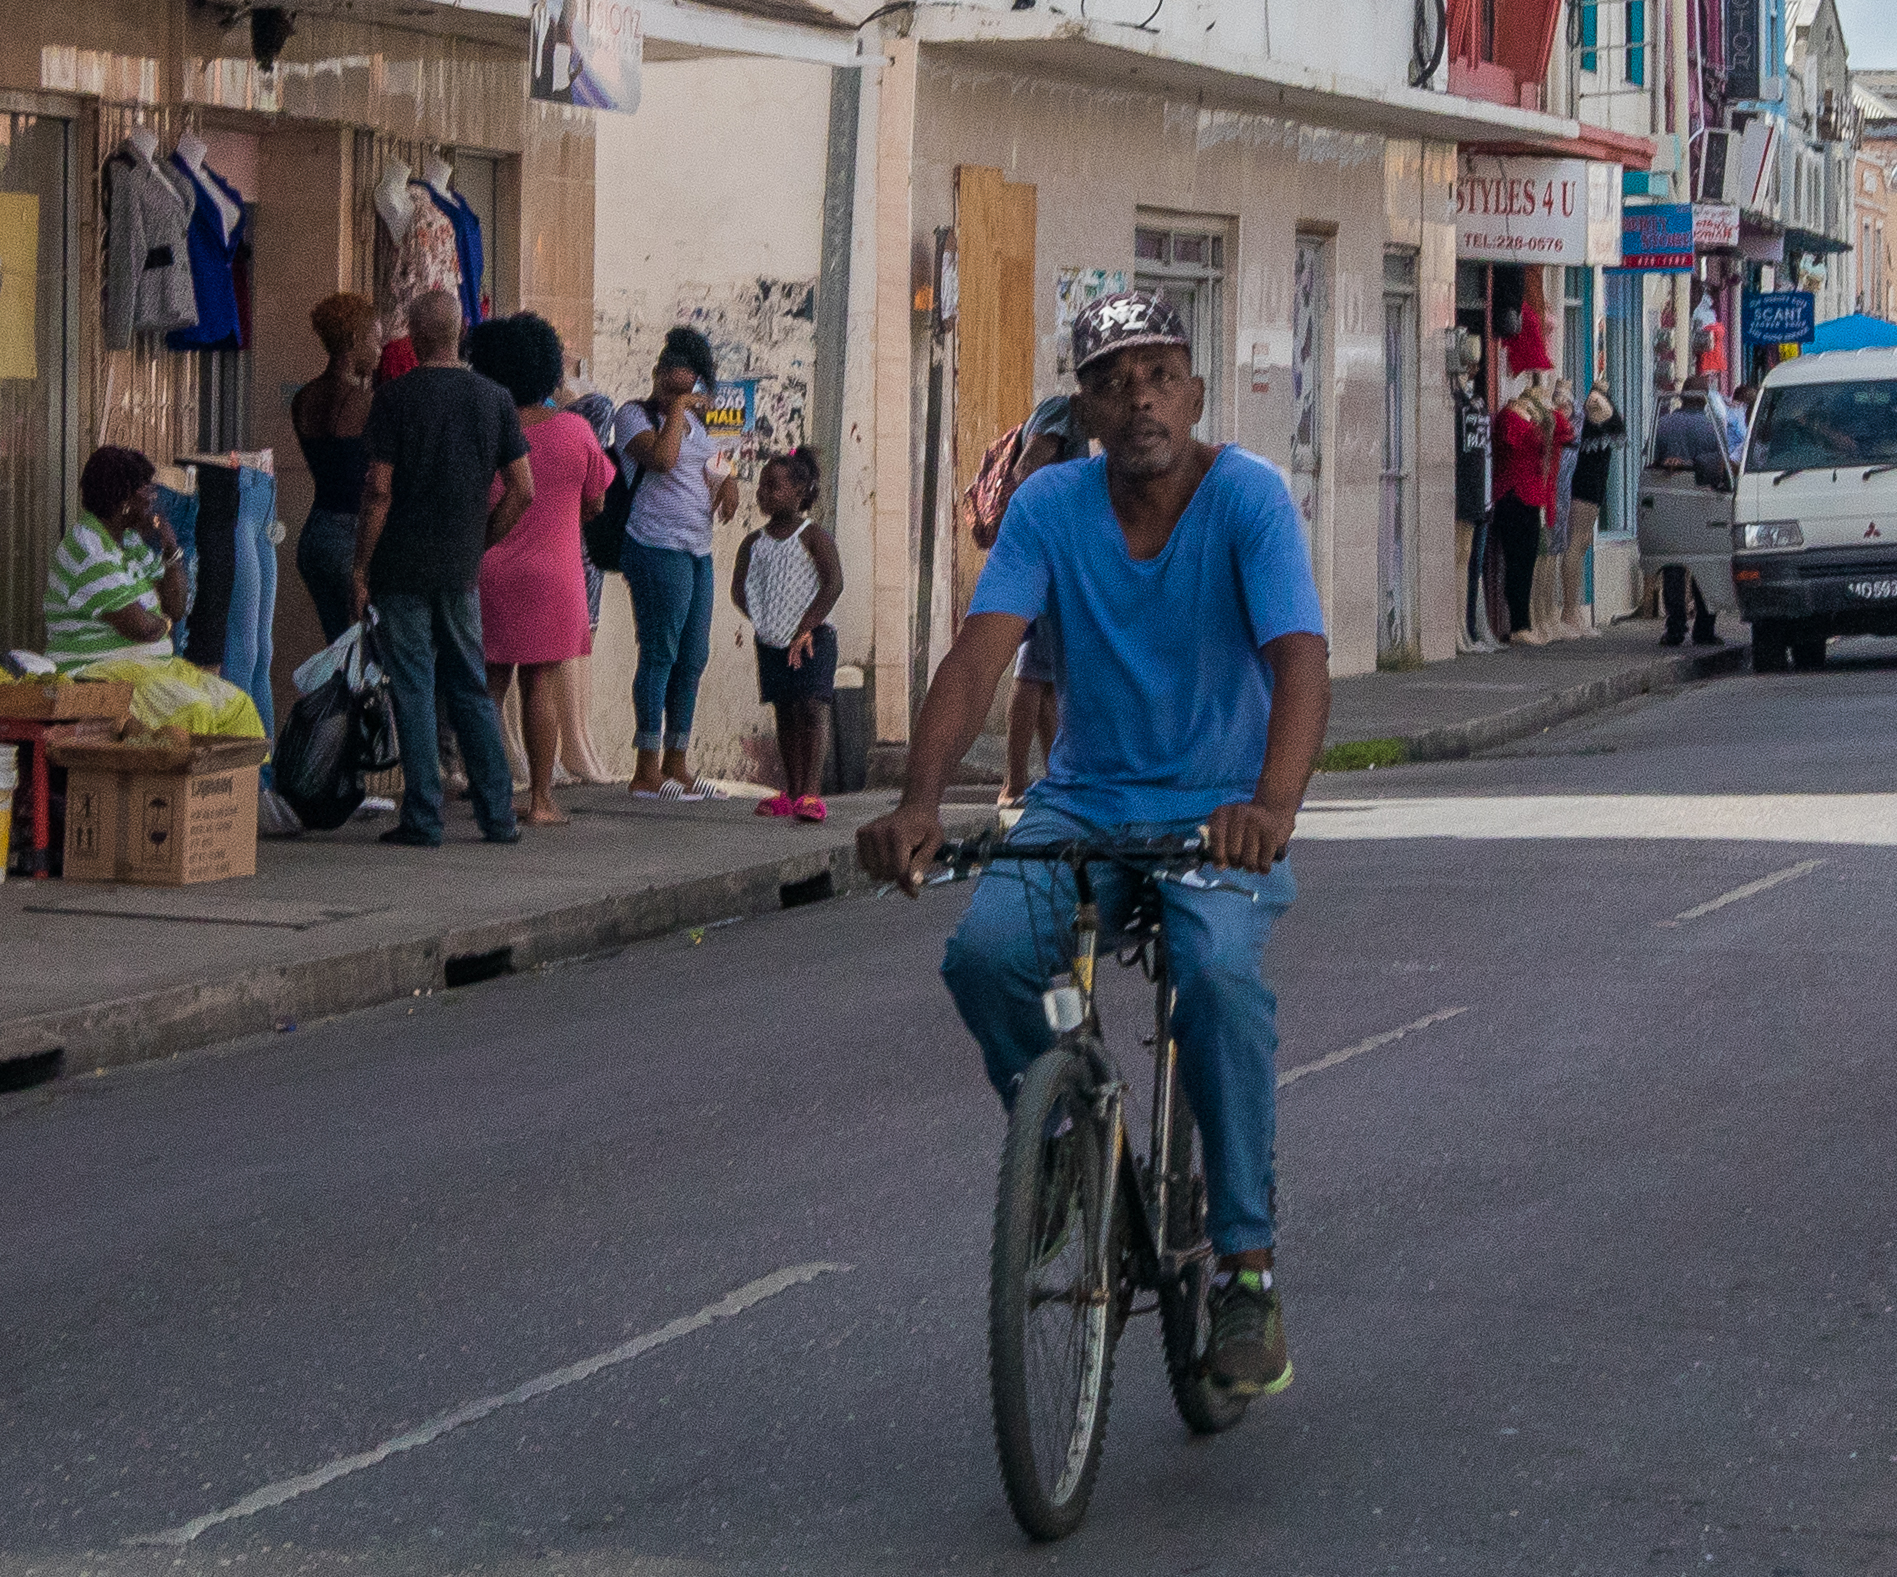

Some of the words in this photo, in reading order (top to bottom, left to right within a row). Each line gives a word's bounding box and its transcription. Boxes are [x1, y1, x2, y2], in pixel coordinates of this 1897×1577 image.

[1457, 176, 1536, 216] STYLES
[1542, 180, 1554, 217] 4
[1561, 180, 1577, 218] U
